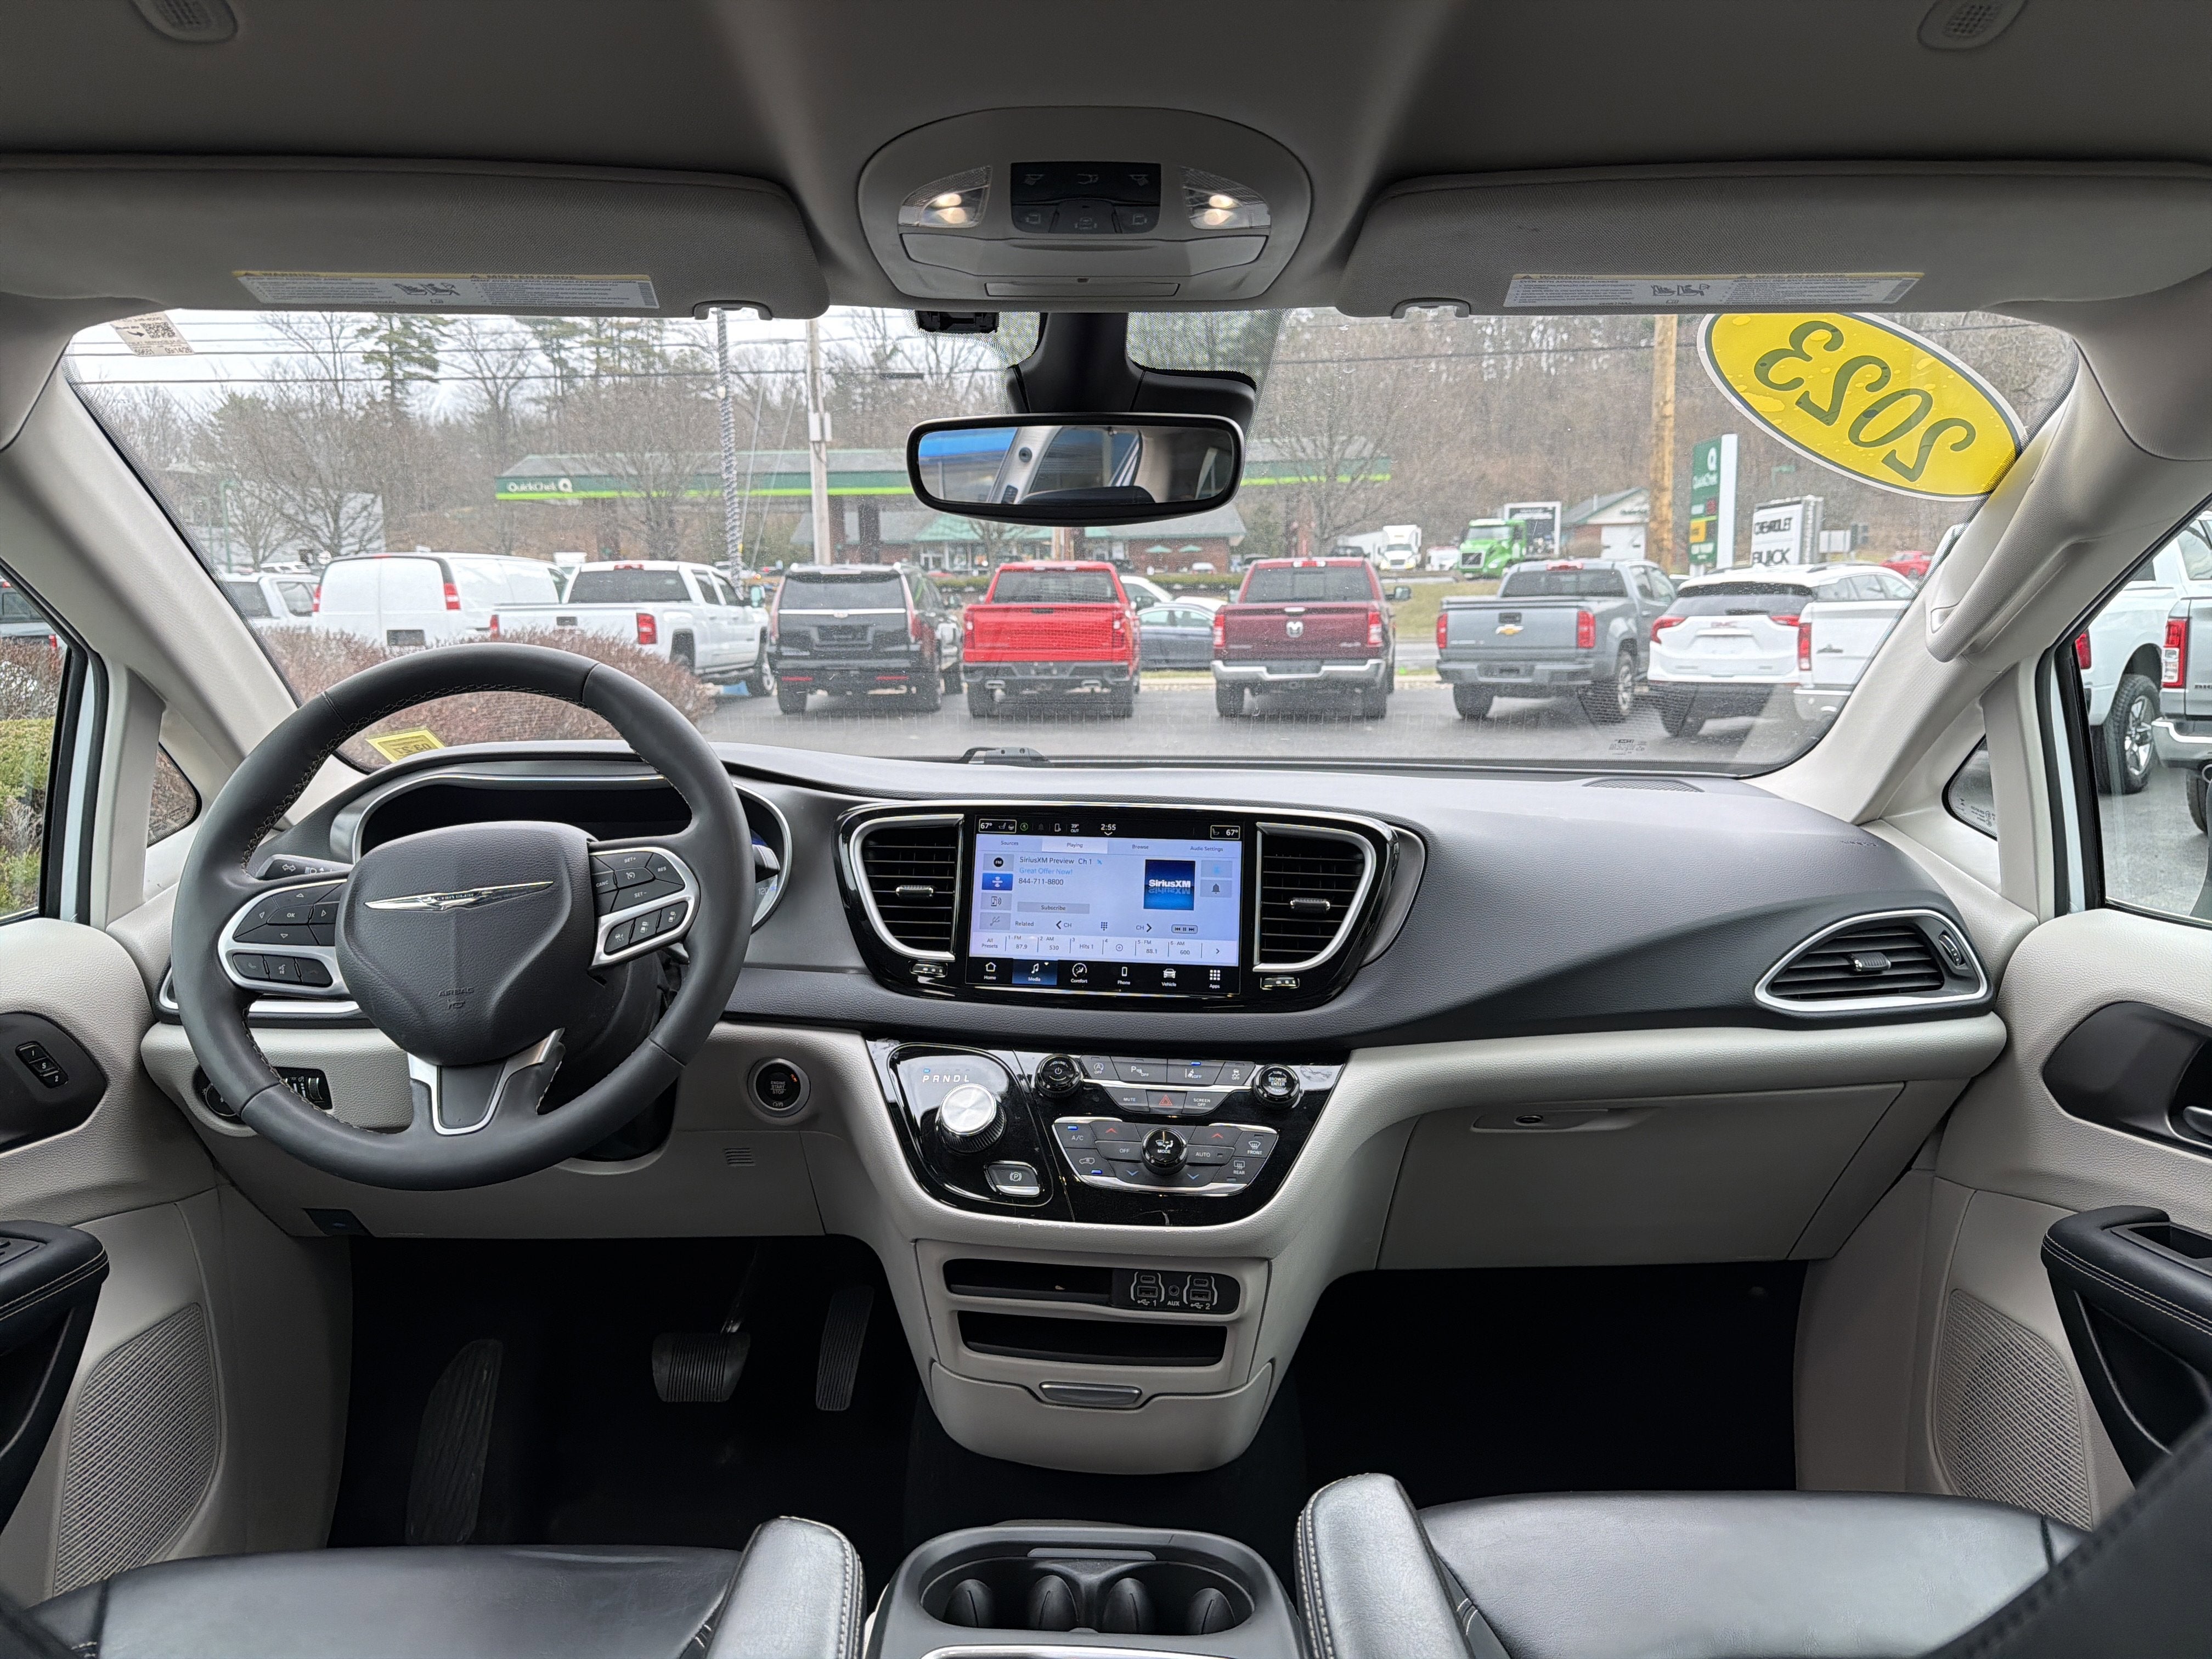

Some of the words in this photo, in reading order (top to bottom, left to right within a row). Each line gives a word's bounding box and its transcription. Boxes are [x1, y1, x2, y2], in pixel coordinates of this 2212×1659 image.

[1753, 548, 1790, 566] BUICK
[1149, 879, 1191, 888] SiriusXM
[758, 887, 769, 895] 120
[438, 987, 475, 997] AIRBAG
